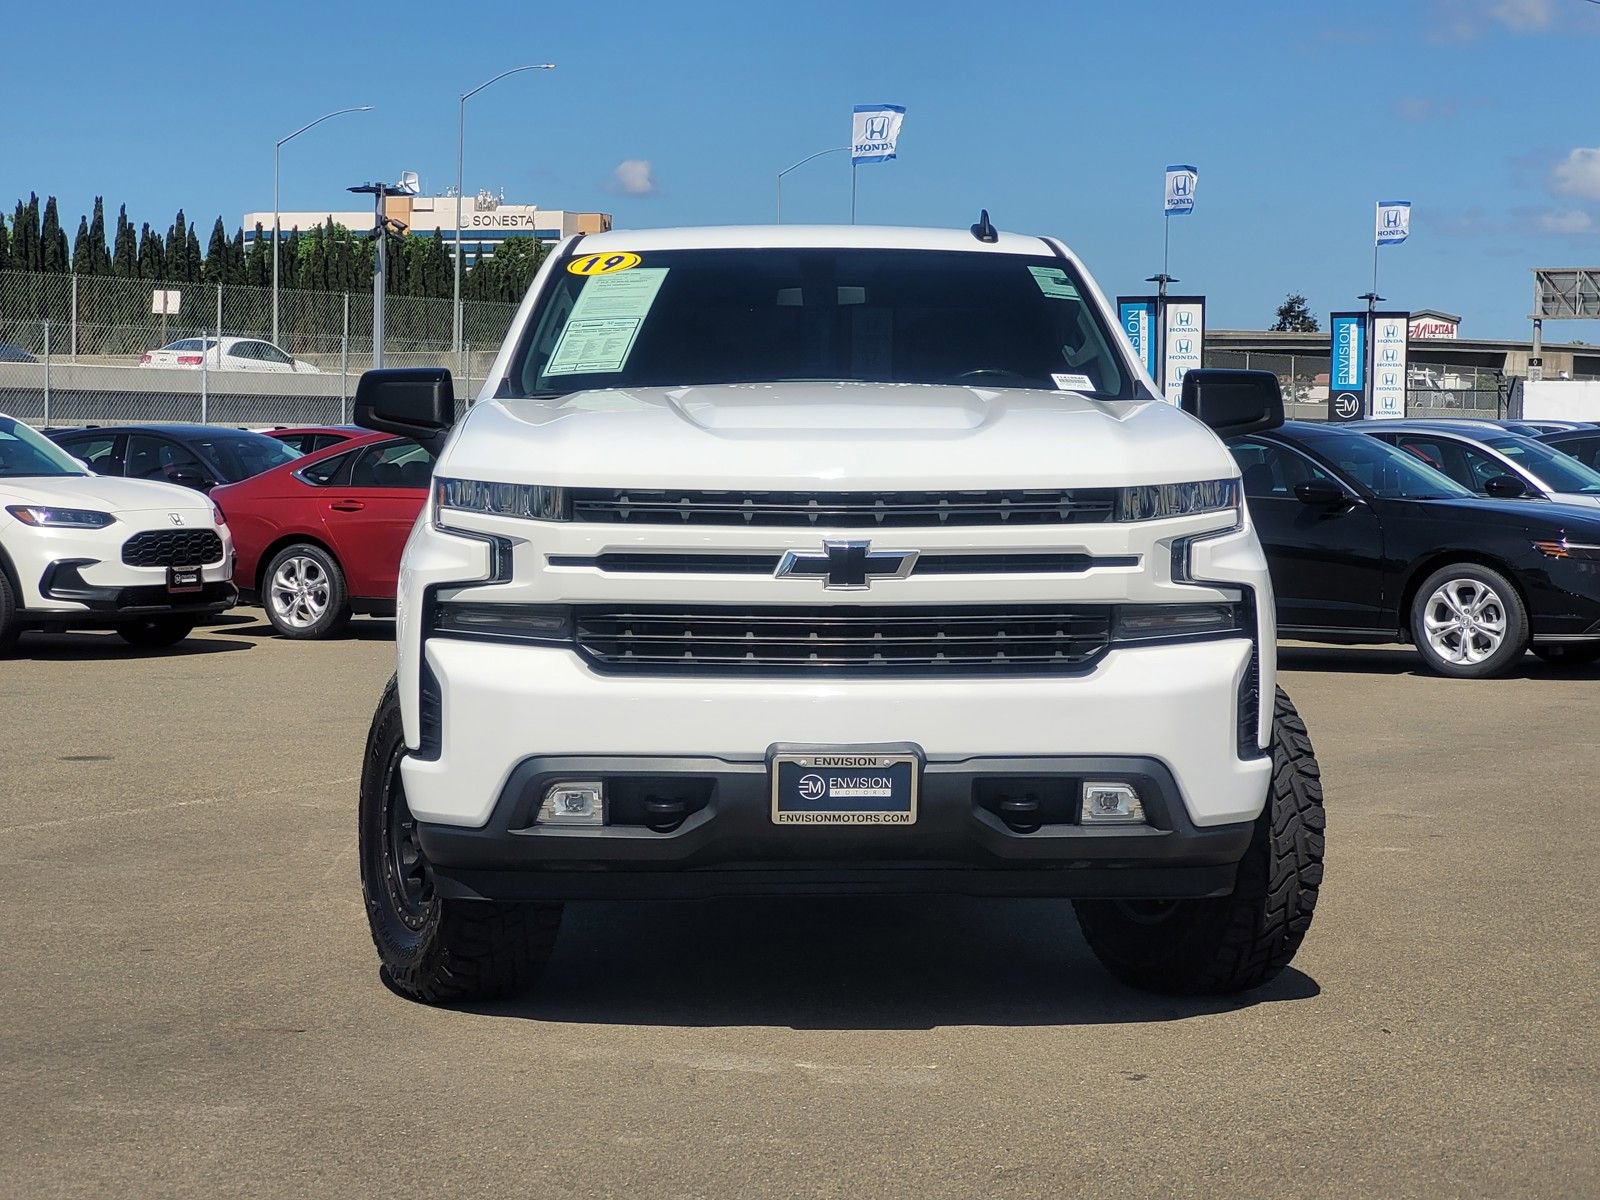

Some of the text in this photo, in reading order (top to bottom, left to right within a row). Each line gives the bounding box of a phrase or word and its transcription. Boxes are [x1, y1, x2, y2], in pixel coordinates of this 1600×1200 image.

[855, 143, 894, 152] HONDA
[472, 215, 534, 226] SONESTA
[581, 255, 625, 272] 19
[1338, 323, 1350, 385] ENVISION
[814, 757, 877, 766] ENVISION
[829, 777, 892, 789] ENVISION
[779, 814, 910, 823] ENVISIONMOTORS.COM
